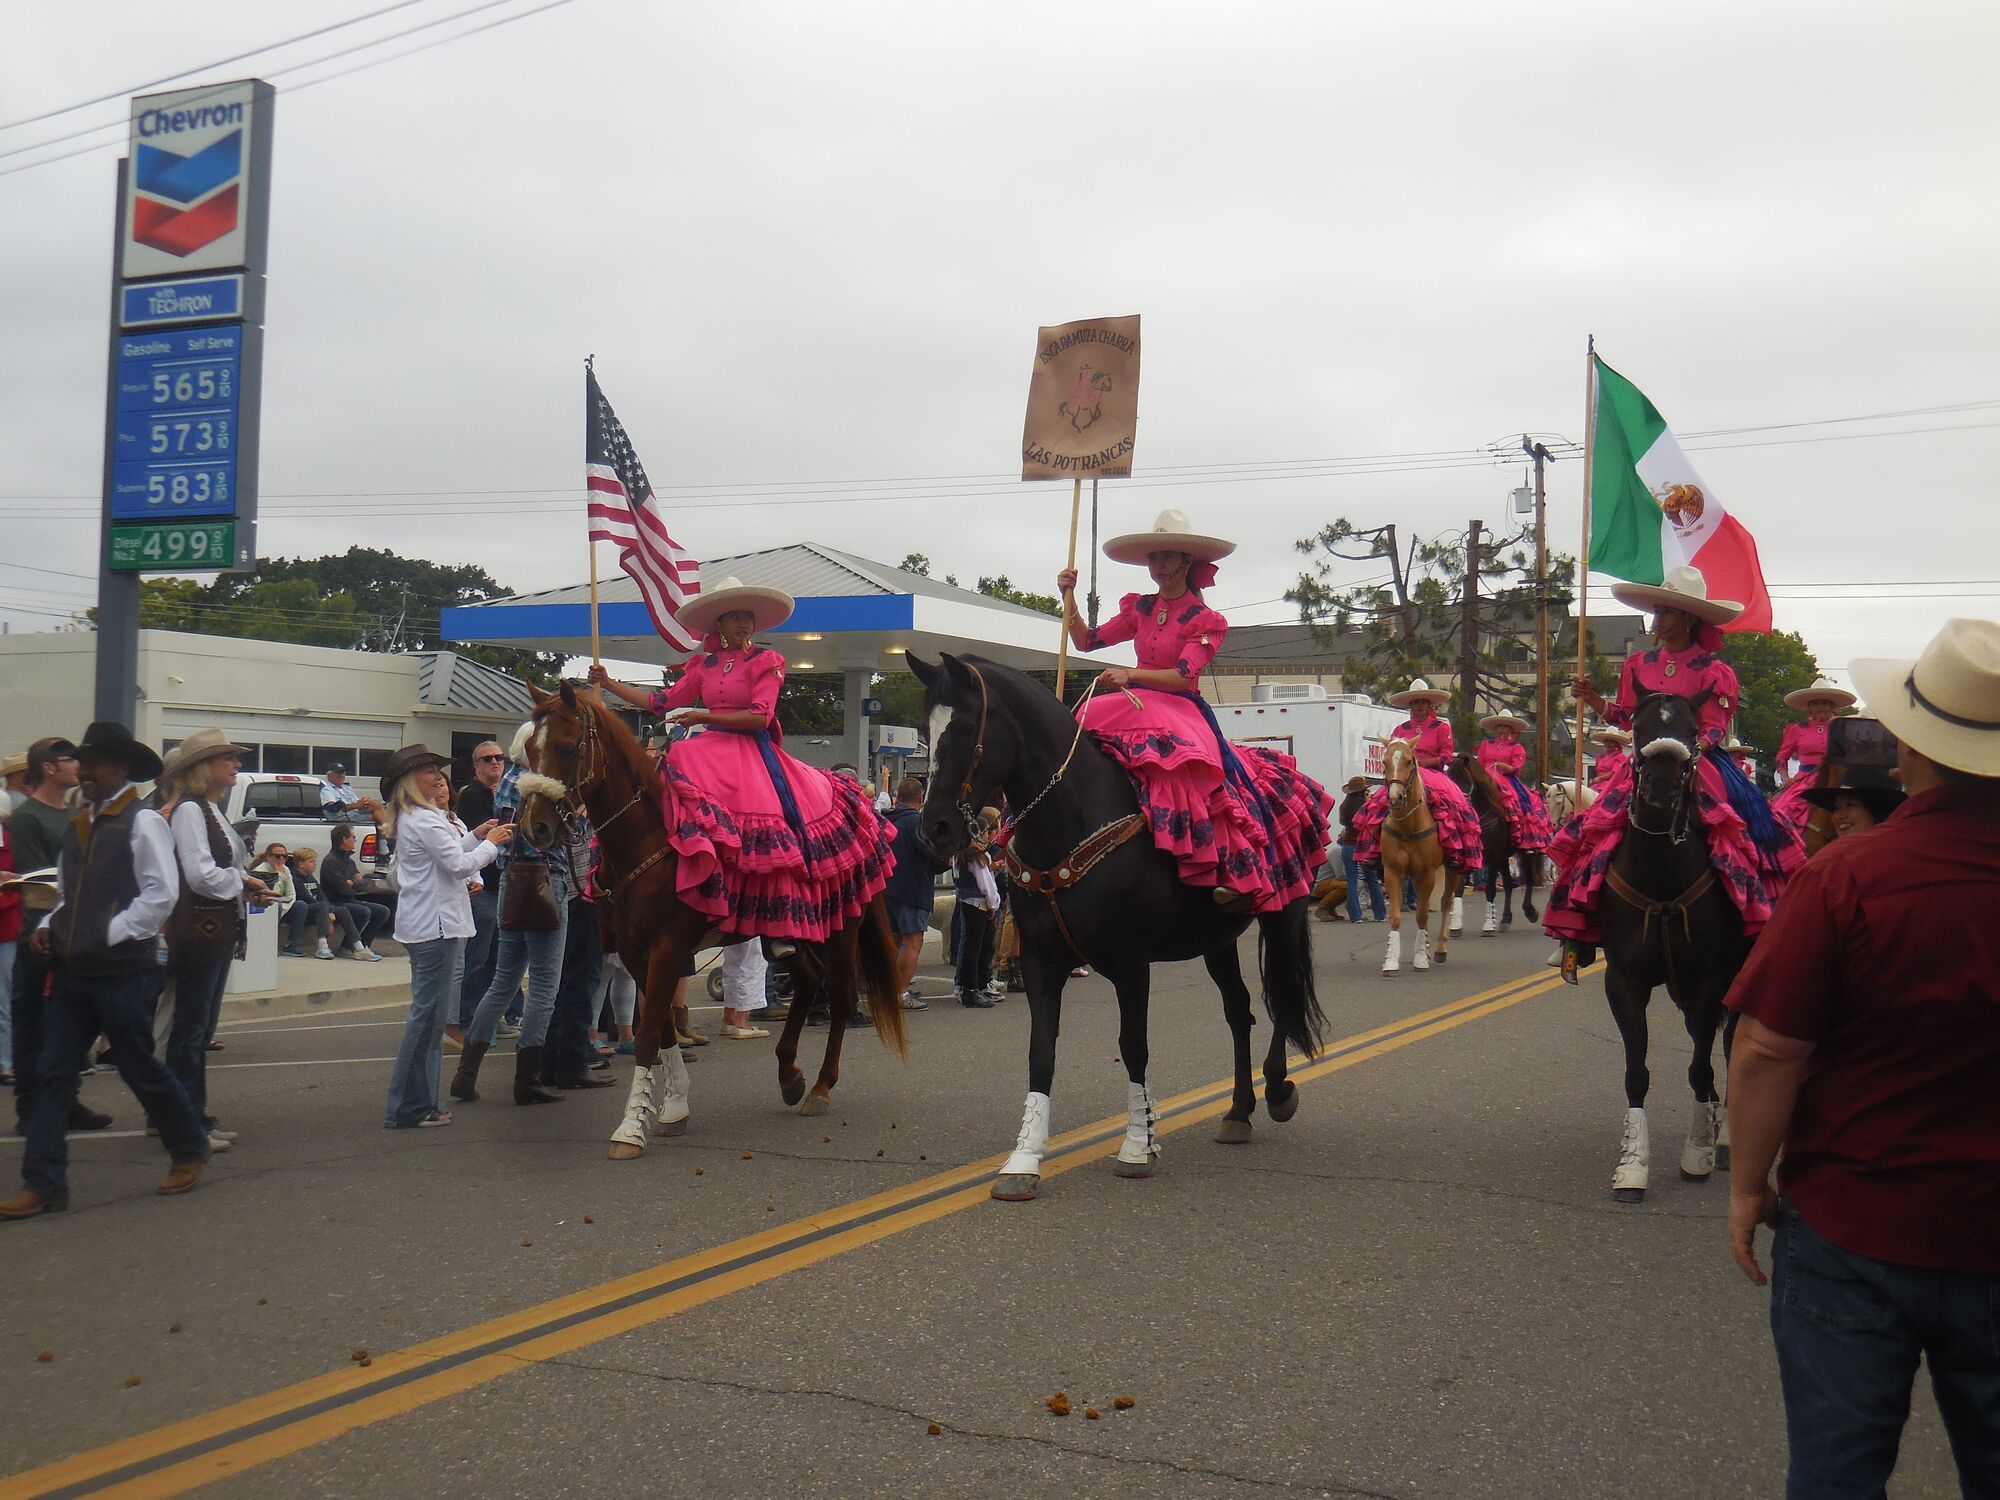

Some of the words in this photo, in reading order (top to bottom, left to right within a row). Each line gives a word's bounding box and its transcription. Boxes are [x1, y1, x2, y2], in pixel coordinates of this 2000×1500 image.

[138, 102, 243, 137] Chevron
[148, 294, 213, 315] TECHRON
[156, 288, 176, 299] with
[123, 342, 171, 357] Gasoline
[207, 337, 235, 349] Serve
[1098, 329, 1135, 356] CHARRA
[153, 370, 215, 404] 565
[151, 422, 213, 453] 573
[1025, 441, 1052, 465] LAS
[1052, 436, 1134, 471] POTRANCAS
[148, 473, 210, 504] 583
[114, 537, 140, 548] Diesel
[143, 531, 208, 560] 499
